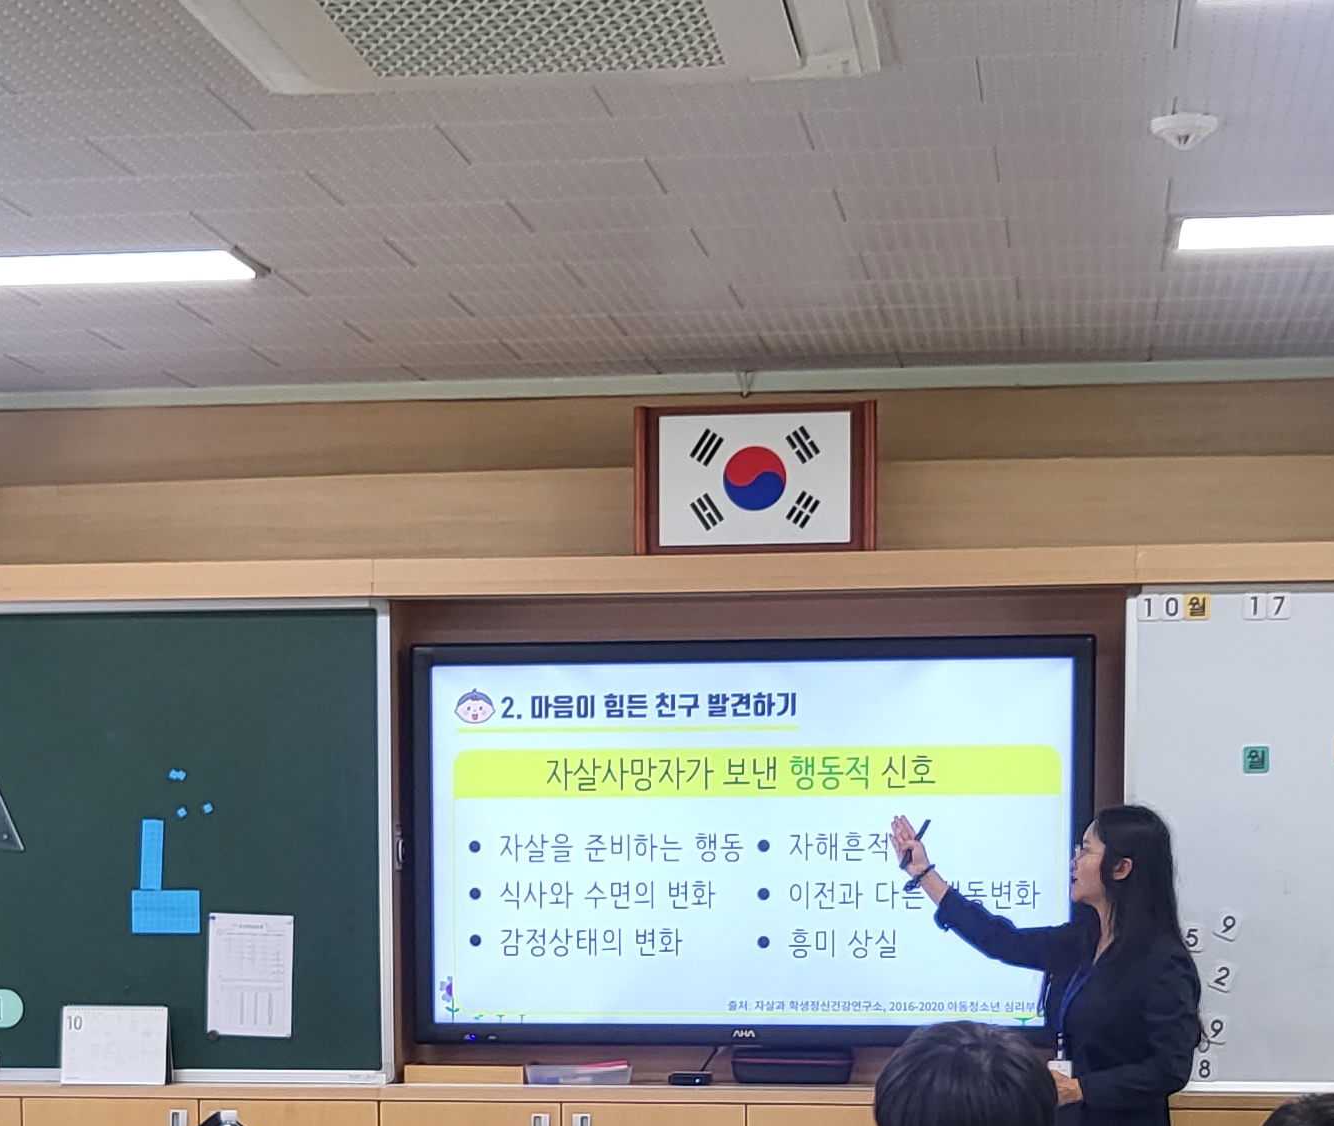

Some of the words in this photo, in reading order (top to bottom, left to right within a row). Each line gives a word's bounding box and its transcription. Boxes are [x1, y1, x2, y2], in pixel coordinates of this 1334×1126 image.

[1250, 596, 1285, 616] 17
[501, 696, 522, 719] 2.
[531, 694, 595, 719] 마음이
[604, 693, 648, 719] 힘든
[655, 692, 700, 718] 친구
[707, 691, 797, 717] 발견하기
[1247, 749, 1265, 769] 월
[546, 756, 714, 791] 자살사망자가
[723, 756, 777, 790] 보낸
[789, 755, 869, 790] 행동적
[881, 755, 936, 789] 신호
[500, 833, 573, 863] 자살을
[584, 833, 683, 863] 준비하는
[695, 833, 744, 863] 행동
[788, 831, 889, 862] 자해흔적
[500, 880, 574, 910] 식사와
[584, 880, 654, 910] 수면의
[668, 880, 716, 910] 변화
[789, 880, 863, 910] 이전과
[1221, 915, 1236, 933] 9
[500, 927, 622, 957] 감정상태의
[635, 928, 684, 957] 변화
[788, 928, 837, 959] 흥미
[847, 928, 897, 959] 상실
[1185, 929, 1198, 947] 5
[1214, 967, 1230, 986] 2
[728, 1000, 751, 1012] 출처:
[754, 1000, 785, 1012] 자살과
[789, 1000, 886, 1014] 학생정신건강연구소,
[889, 1001, 944, 1012] 2016-2020
[947, 1001, 1000, 1012] 아동청소년
[67, 1015, 82, 1030] 10
[1210, 1019, 1224, 1038] 9
[1198, 1059, 1211, 1078] 8
